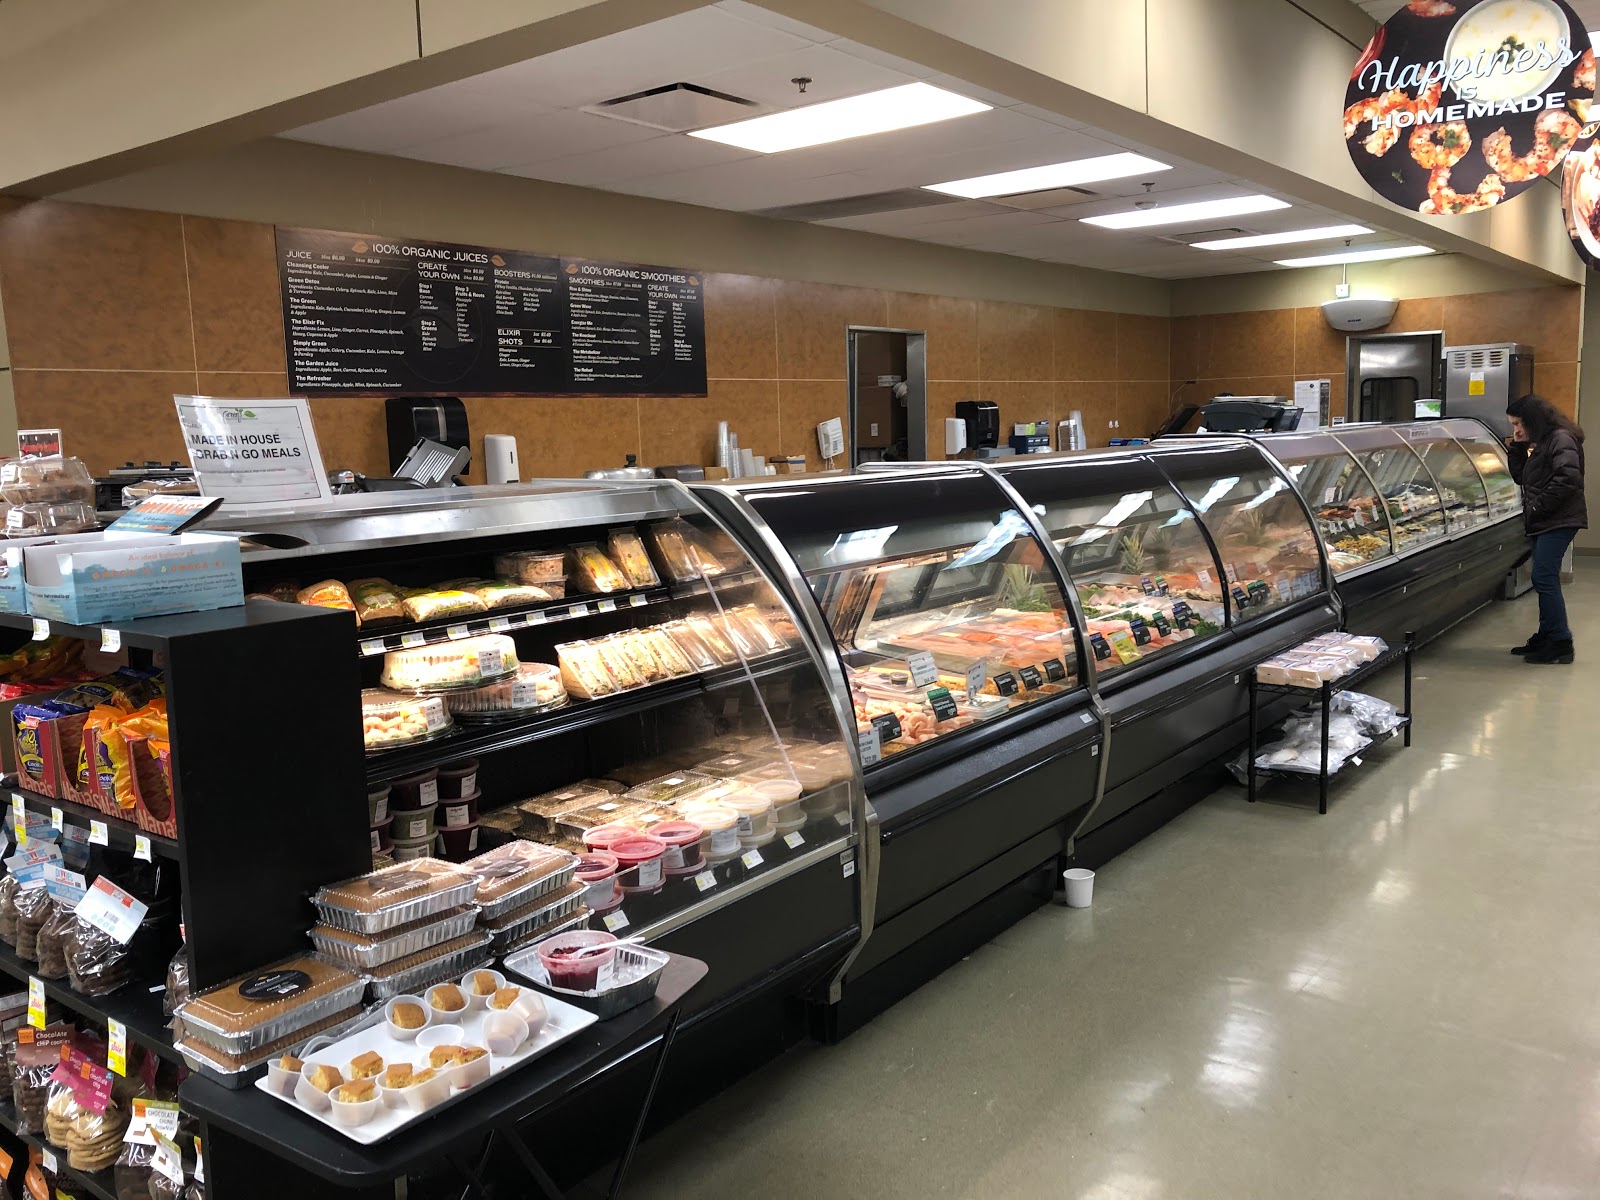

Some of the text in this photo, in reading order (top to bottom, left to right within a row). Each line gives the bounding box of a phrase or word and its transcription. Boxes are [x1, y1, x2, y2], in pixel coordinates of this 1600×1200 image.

[1358, 38, 1581, 94] Happiness
[1456, 86, 1477, 100] IS
[1371, 92, 1566, 131] HOMEMADE
[286, 250, 312, 260] JUICE
[373, 244, 488, 263] 100% ORGANIC JUICES
[286, 261, 312, 270] Cleansing
[418, 262, 448, 271] CREATE
[418, 270, 460, 280] YOUR OWN
[494, 270, 530, 279] BOOSTERS
[581, 266, 686, 284] 100% ORGANIC SMOOTHIES
[569, 277, 605, 286] SMOOTHIES
[191, 434, 281, 445] MADE IN HOUSE
[196, 447, 301, 460] GRAB N GO MEALS
[18, 772, 55, 798] Nana's
[60, 780, 101, 808] Nana's
[148, 1110, 175, 1118] CHOCOLATE
